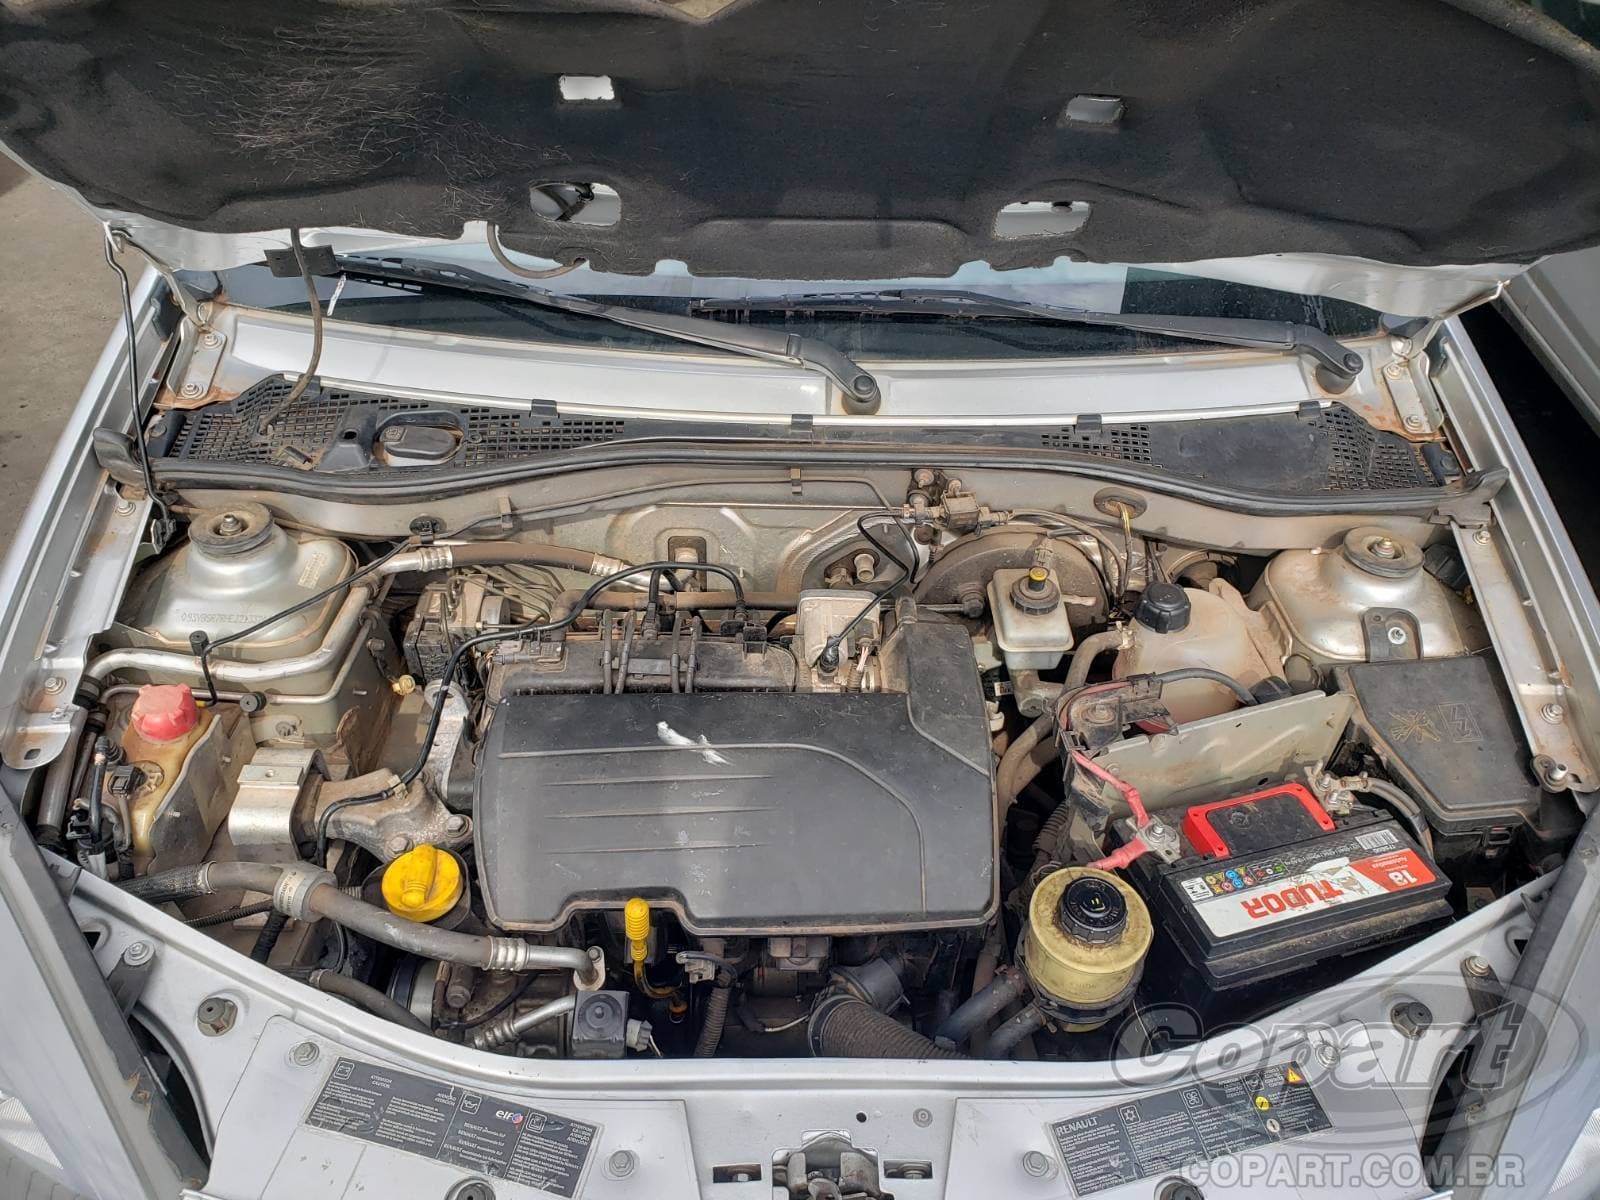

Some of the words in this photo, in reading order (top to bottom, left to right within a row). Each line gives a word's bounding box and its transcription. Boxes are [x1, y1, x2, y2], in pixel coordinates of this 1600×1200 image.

[1386, 867, 1419, 887] 18
[1241, 878, 1344, 919] TUDOR
[1055, 1116, 1099, 1135] RENAULT
